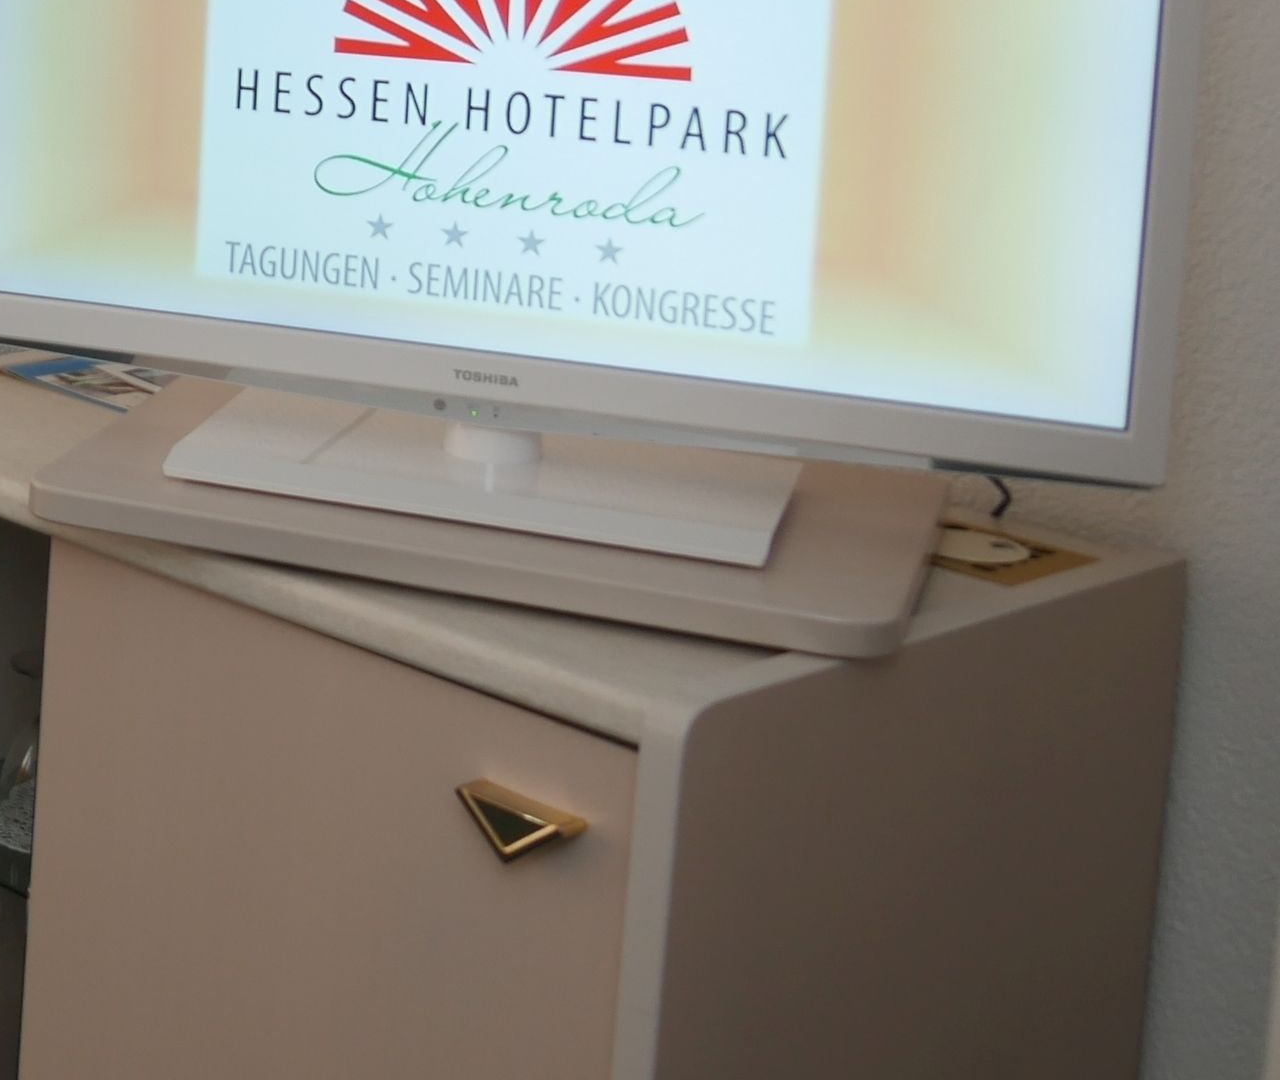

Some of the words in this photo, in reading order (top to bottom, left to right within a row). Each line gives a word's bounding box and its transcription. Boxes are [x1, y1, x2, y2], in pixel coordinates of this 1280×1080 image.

[236, 68, 430, 128] HESSEN
[466, 88, 792, 160] HOTELPARK
[314, 119, 705, 228] Hohenroda
[225, 240, 382, 294] TAGUNGEN
[408, 262, 564, 312] SEMINARE
[592, 282, 778, 338] KONGRESSE
[453, 368, 519, 387] TOSHIBA
